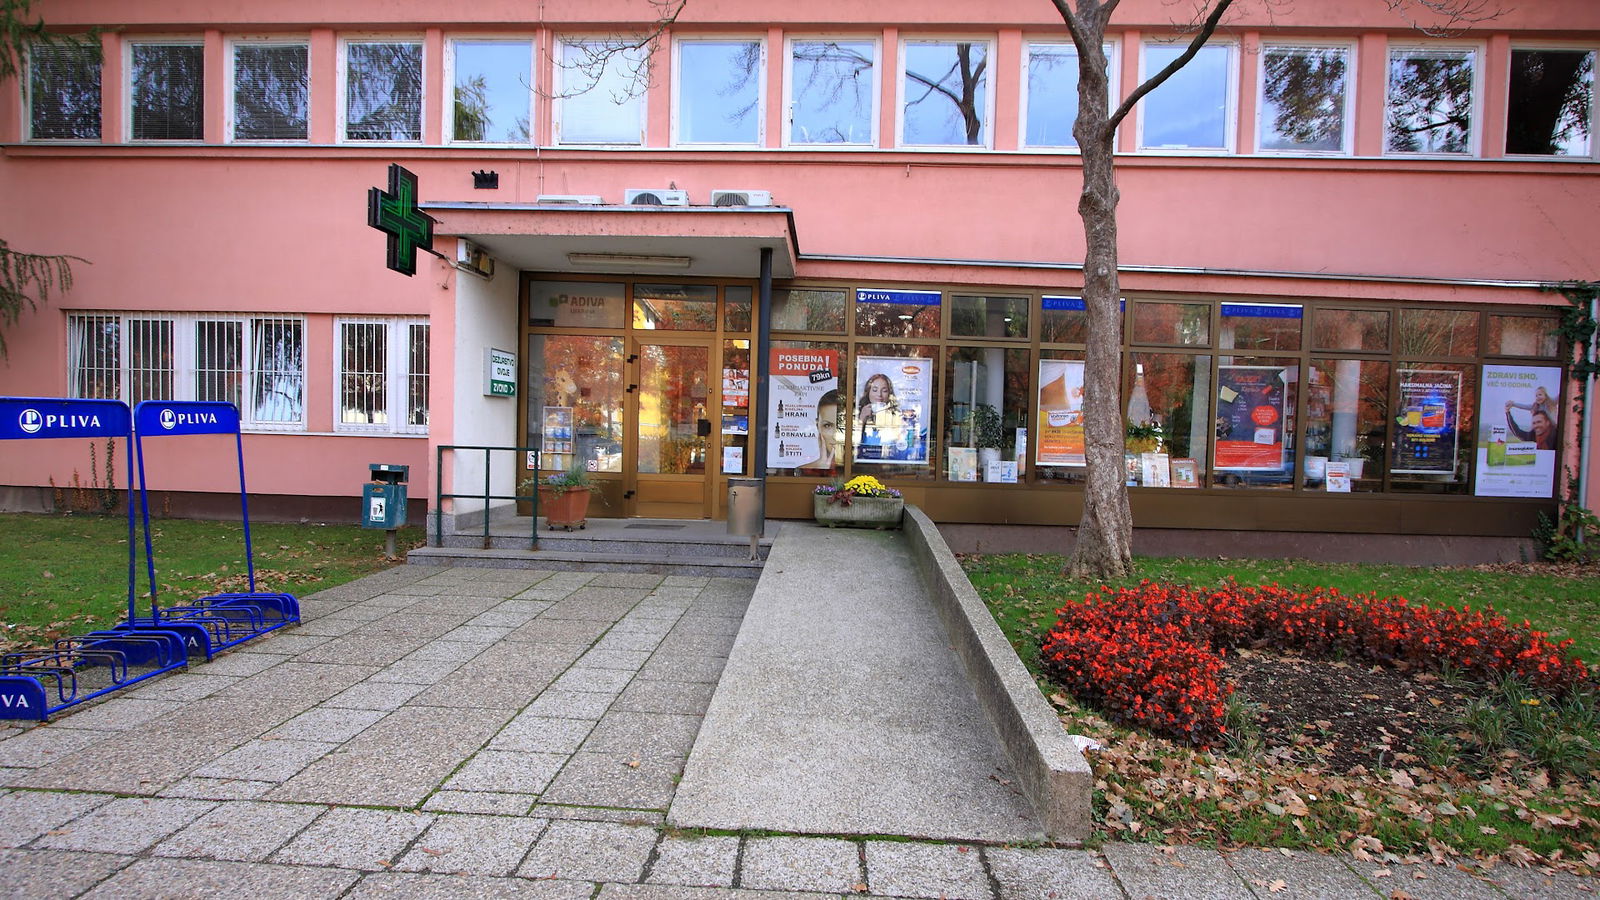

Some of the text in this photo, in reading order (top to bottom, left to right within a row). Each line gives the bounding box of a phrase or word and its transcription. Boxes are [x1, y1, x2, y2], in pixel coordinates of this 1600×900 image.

[570, 296, 605, 306] ADIVA
[779, 354, 824, 363] POSEBNA
[779, 363, 824, 371] PONUDA
[1487, 371, 1517, 379] ZDRAVI
[46, 414, 101, 428] PLIVA
[178, 412, 218, 425] PLIVA
